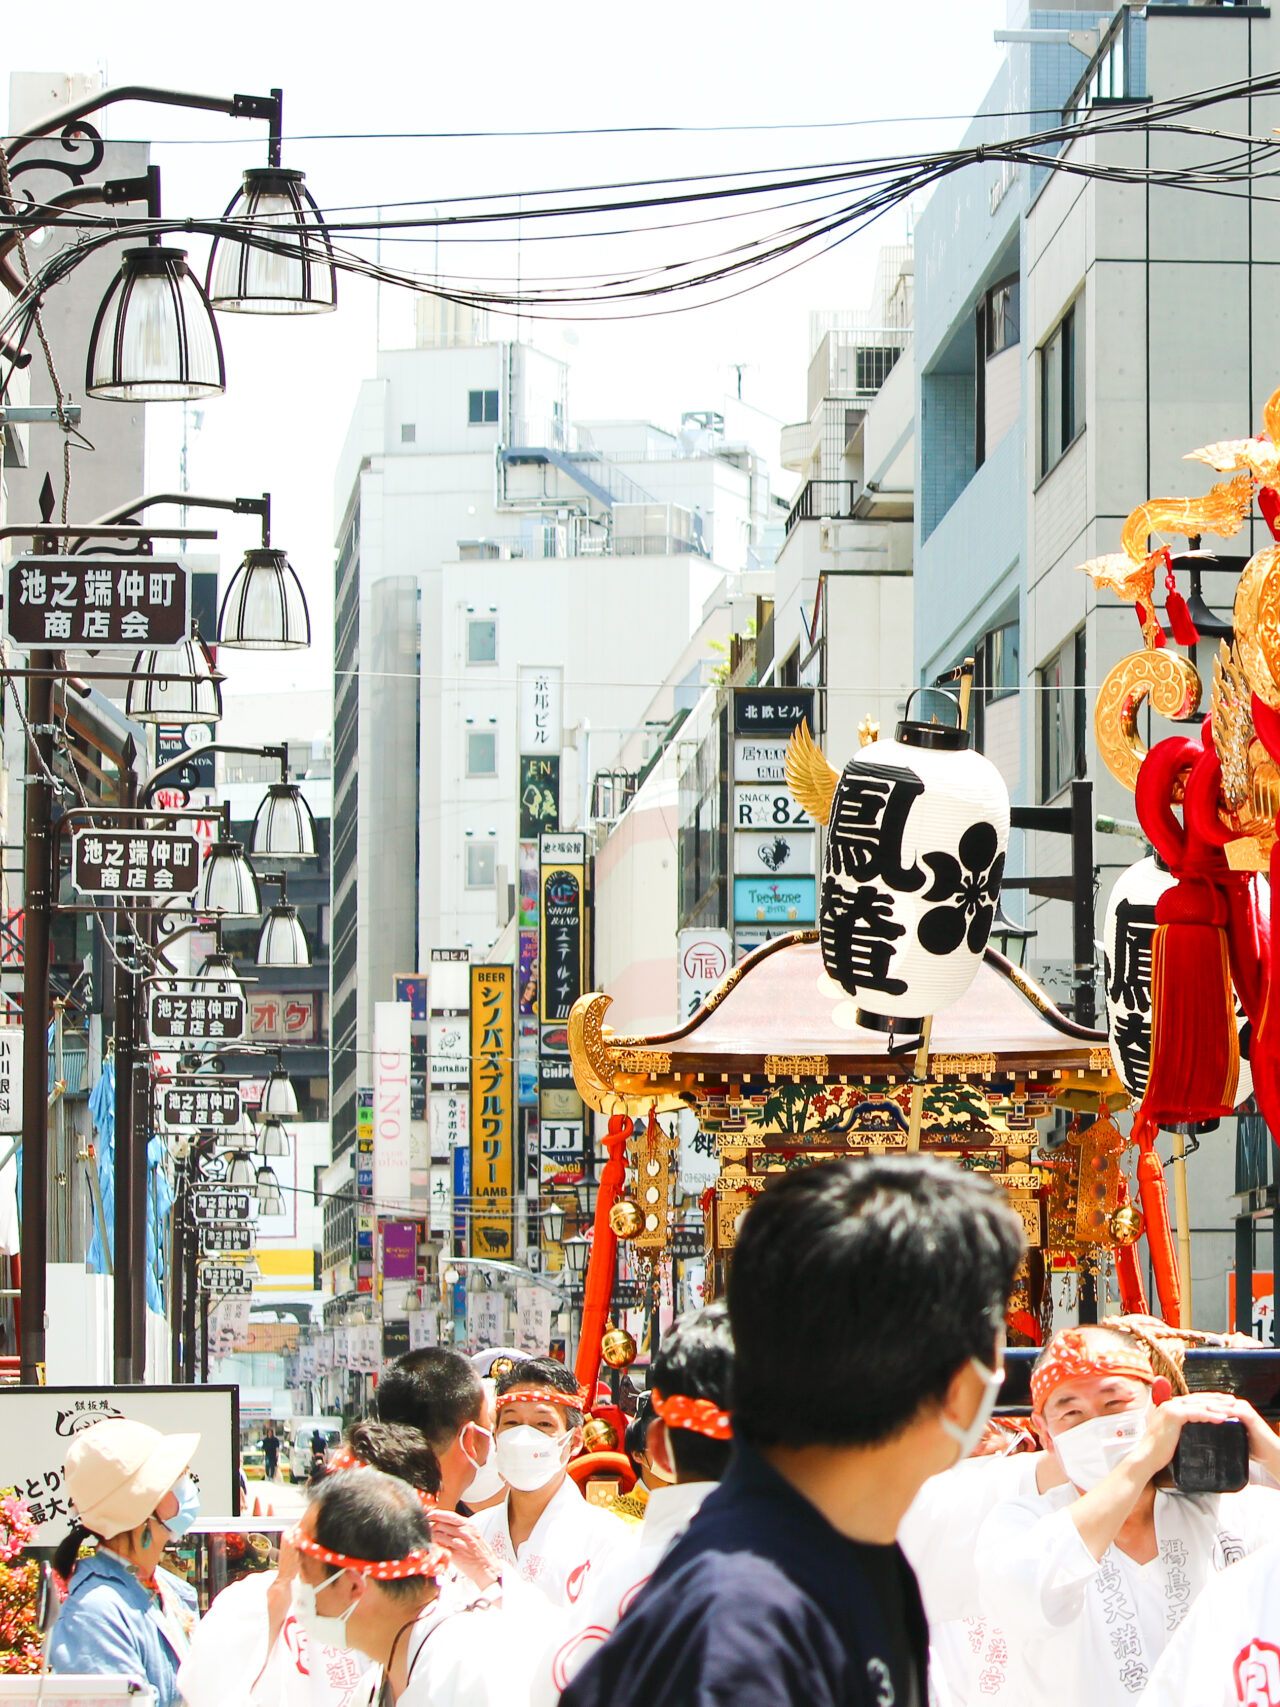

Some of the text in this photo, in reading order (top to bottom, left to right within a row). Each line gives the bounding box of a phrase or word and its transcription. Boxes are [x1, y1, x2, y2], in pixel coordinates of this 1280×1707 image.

[19, 568, 176, 607] 池之端仲町
[44, 611, 149, 639] 商店会
[745, 704, 803, 719] 北欧ビル
[739, 793, 770, 802] SNACK
[84, 839, 192, 867] 池之端仲町
[100, 869, 173, 889] 商店会
[551, 916, 579, 926] BAND
[478, 972, 505, 983] BEER
[158, 999, 238, 1019] 池之端仲町
[170, 1021, 224, 1035] 商店会
[379, 1049, 408, 1139] DINO
[480, 986, 504, 1184] シノバズブルワリー
[169, 1093, 235, 1110] 池之端仲町
[180, 1111, 224, 1124] 商店会
[476, 1186, 507, 1197] LAMB
[1094, 1548, 1149, 1694] 島天満宮
